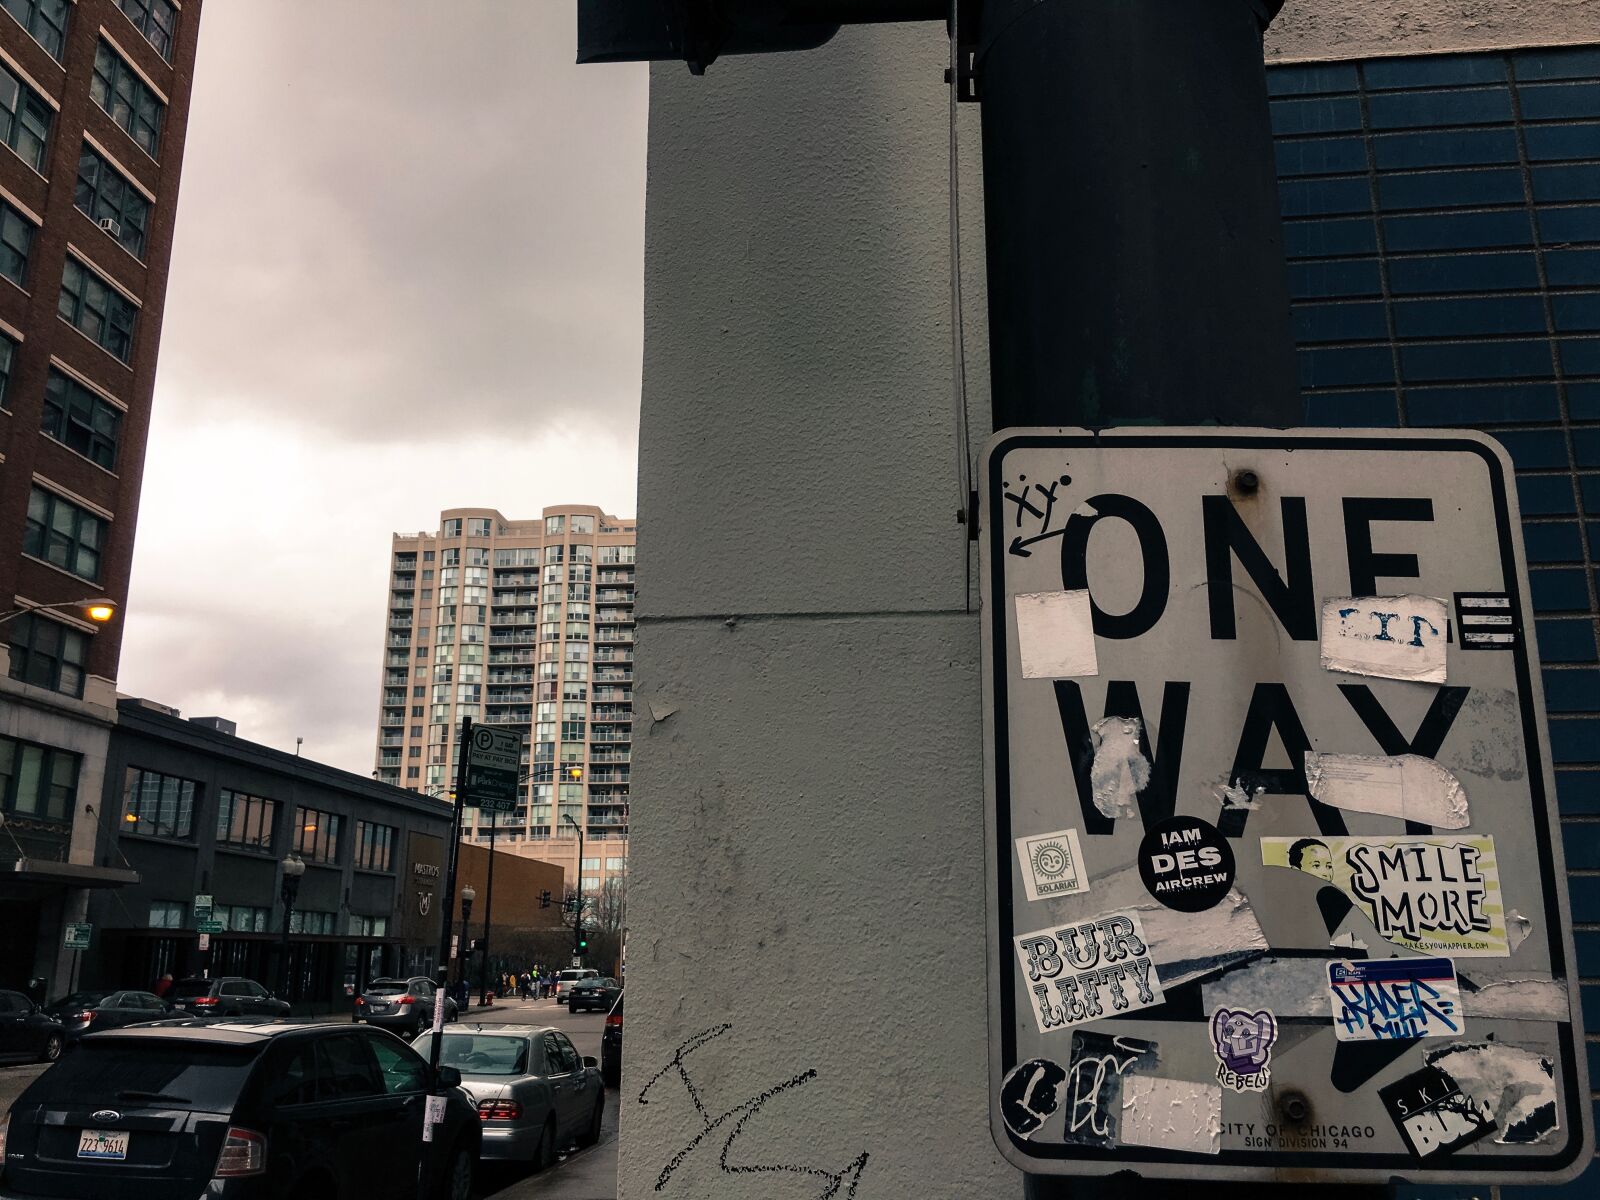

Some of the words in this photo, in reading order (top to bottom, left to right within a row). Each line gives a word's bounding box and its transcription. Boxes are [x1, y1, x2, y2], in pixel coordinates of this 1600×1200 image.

[1061, 493, 1453, 643] ONE
[1053, 680, 1471, 837] WAY
[480, 798, 495, 808] 232
[1152, 846, 1222, 876] DES
[1350, 846, 1483, 893] SMILE
[1037, 880, 1078, 895] SOLARIAT
[1155, 872, 1228, 893] AIRCREW
[1378, 889, 1490, 938] MORE
[1020, 915, 1147, 981] BUR
[1033, 957, 1155, 1028] LEFTY
[1217, 1063, 1268, 1090] REBELS
[1220, 1122, 1255, 1136] CITY
[1298, 1125, 1375, 1138] CHICAGO
[1245, 1137, 1272, 1148] SIGN
[1279, 1137, 1327, 1149] DIVISION
[1333, 1138, 1348, 1149] 94
[103, 1139, 124, 1154] 9614
